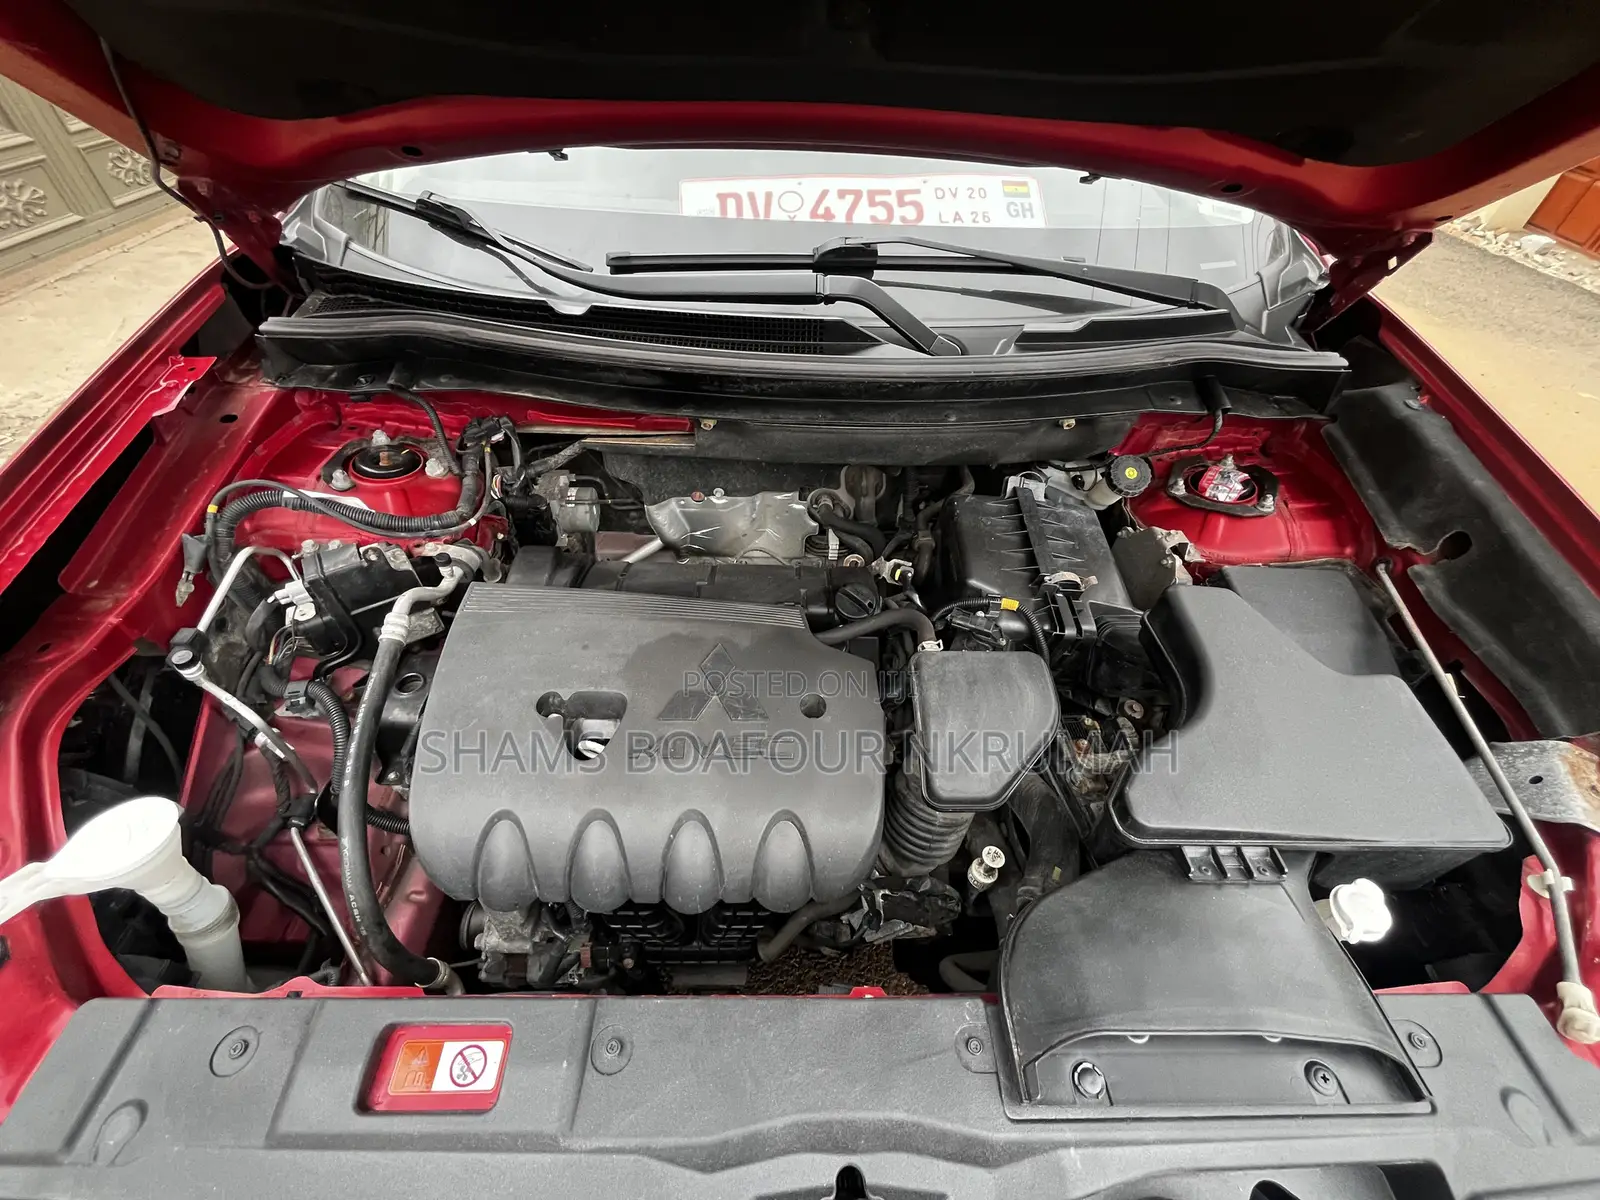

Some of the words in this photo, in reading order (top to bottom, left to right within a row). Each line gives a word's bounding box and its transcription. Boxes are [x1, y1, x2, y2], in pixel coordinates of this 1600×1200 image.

[934, 187, 958, 200] DV
[966, 187, 987, 199] 20
[809, 189, 924, 225] 4755
[1006, 201, 1034, 219] GH
[938, 211, 964, 224] LA
[970, 211, 991, 224] 26
